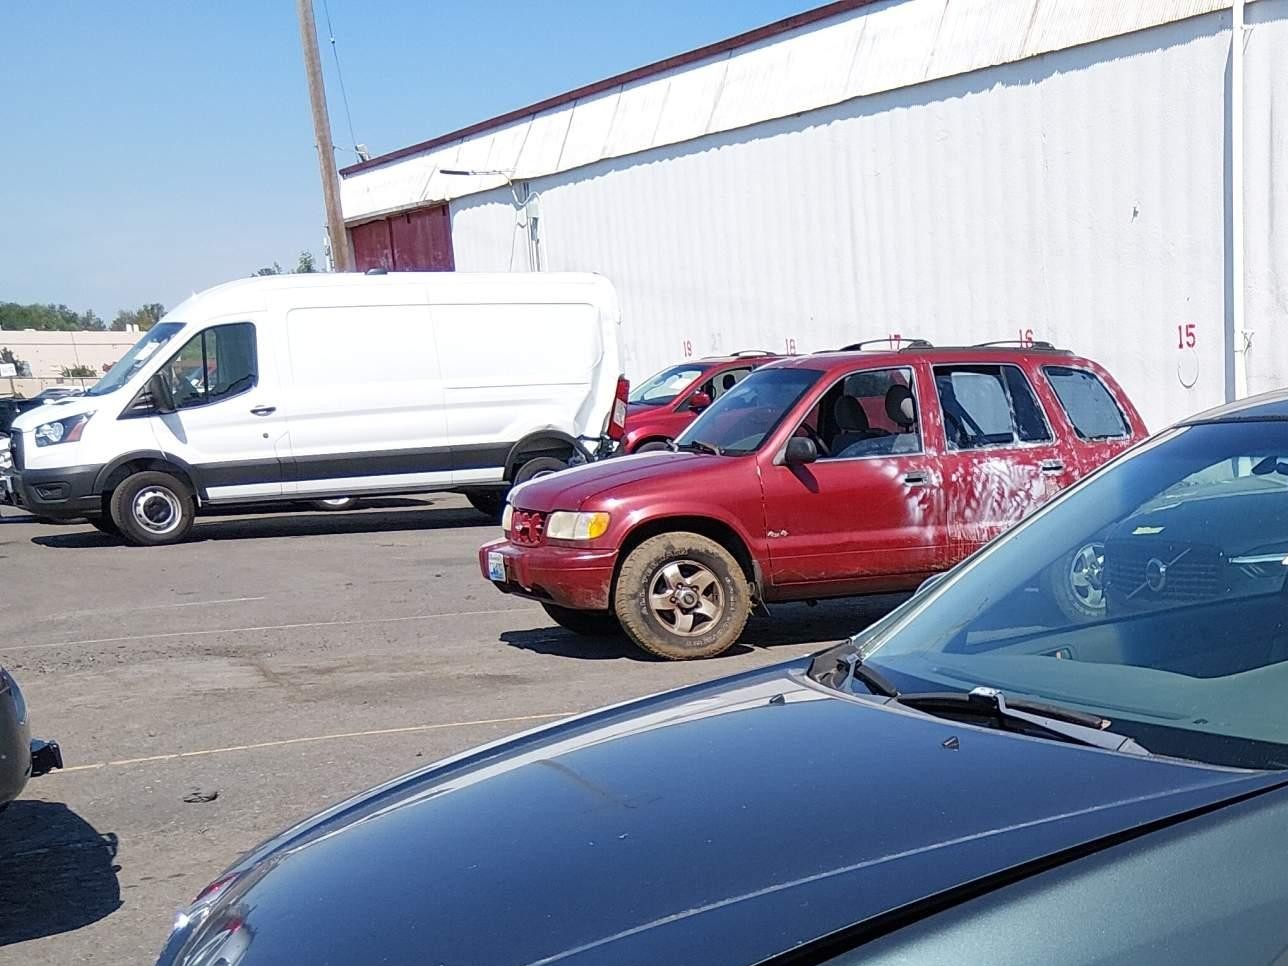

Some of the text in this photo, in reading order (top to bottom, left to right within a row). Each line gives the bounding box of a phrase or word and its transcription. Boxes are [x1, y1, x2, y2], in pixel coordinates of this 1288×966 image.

[889, 333, 901, 350] 17
[1178, 324, 1196, 349] 15
[682, 340, 692, 356] 19
